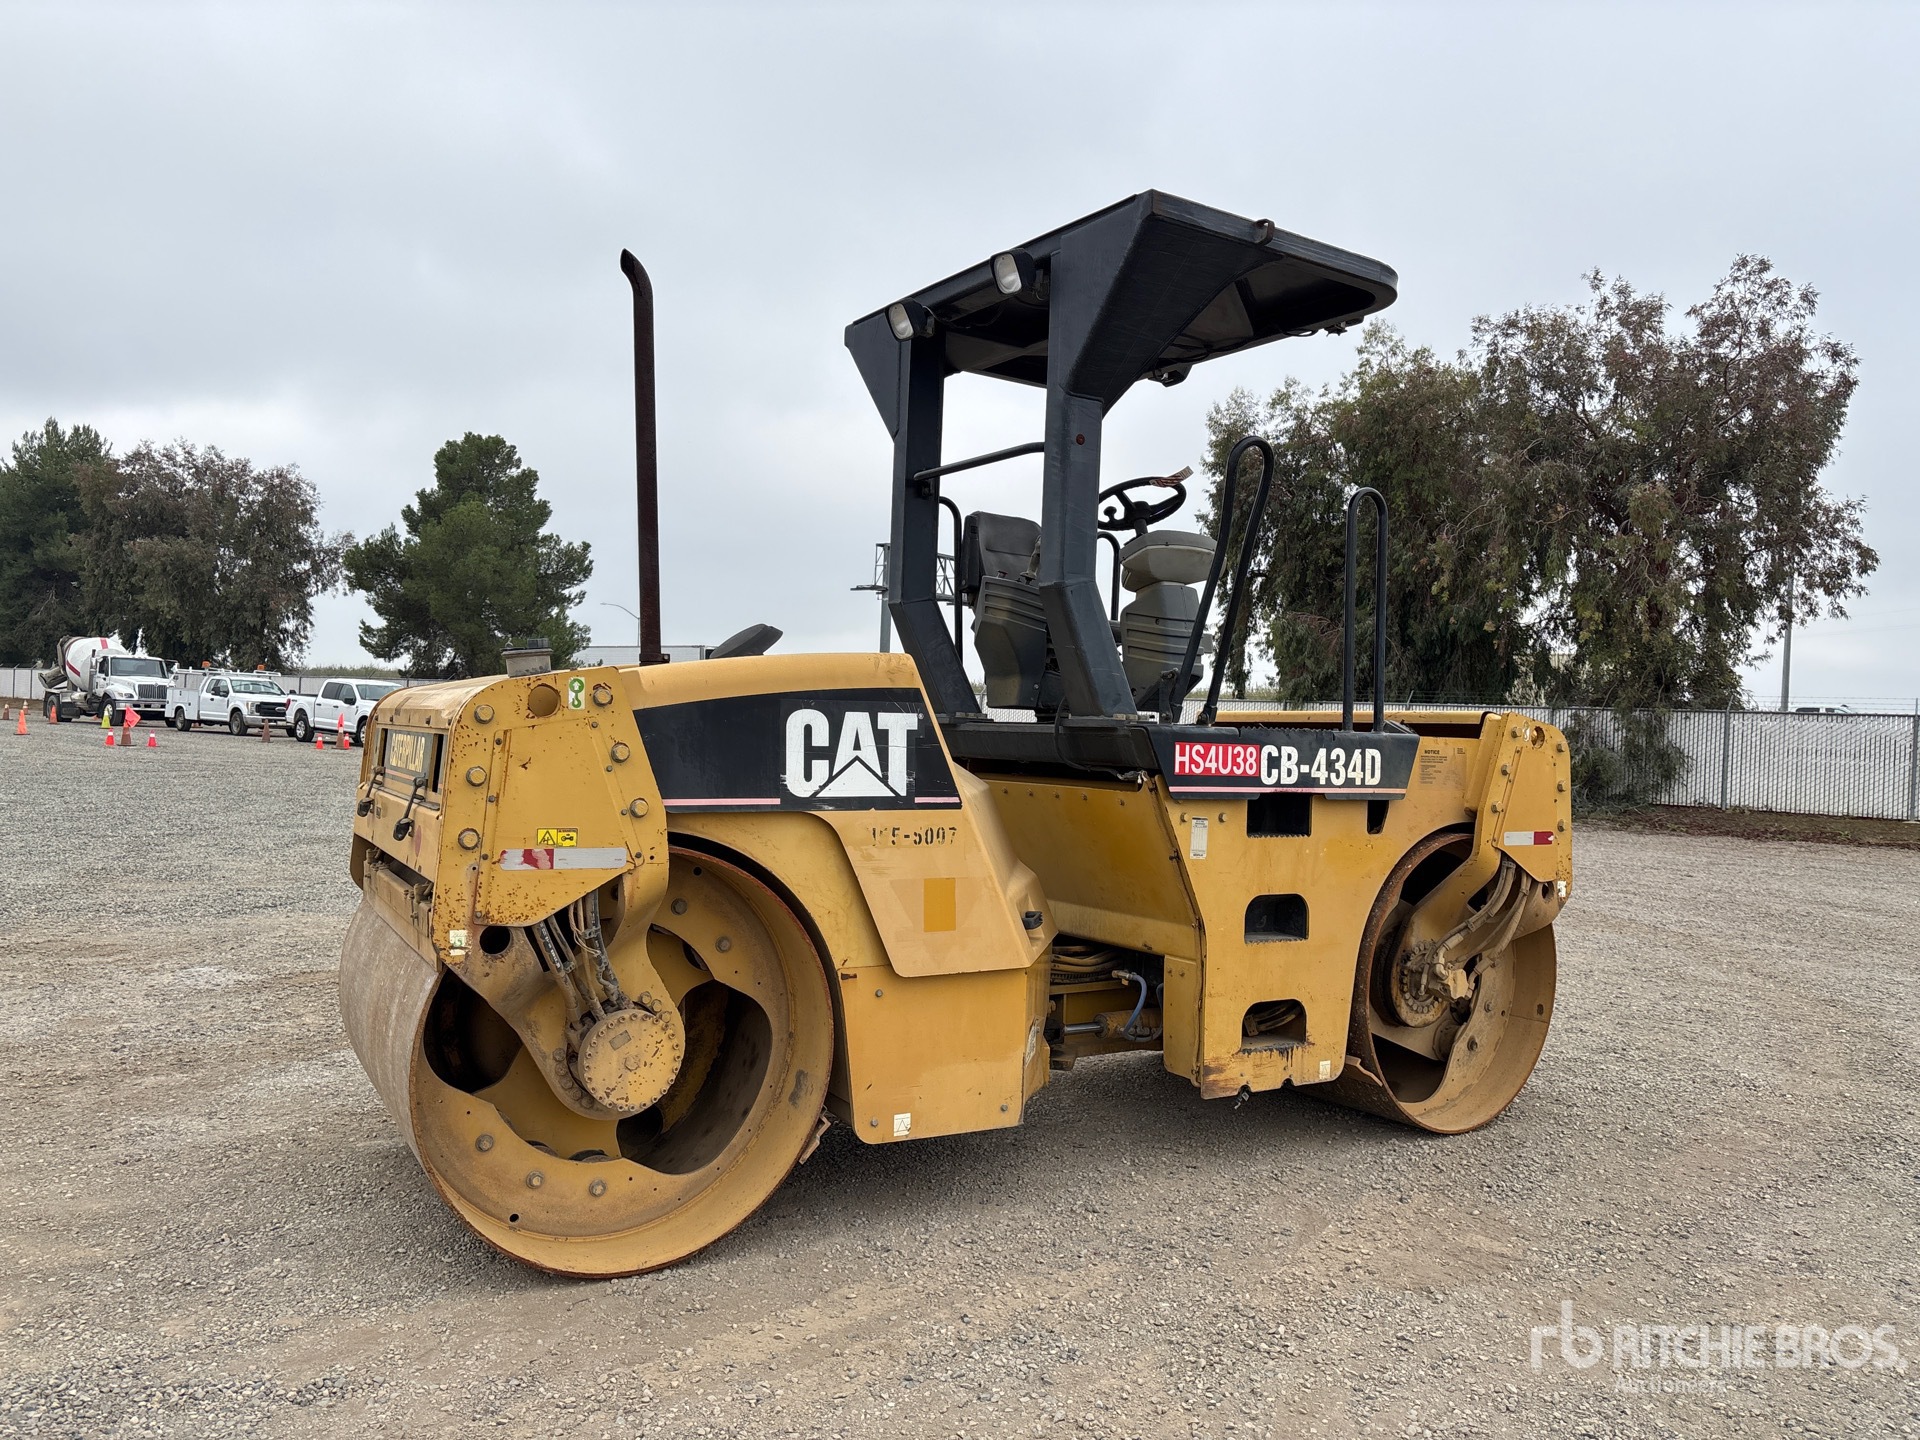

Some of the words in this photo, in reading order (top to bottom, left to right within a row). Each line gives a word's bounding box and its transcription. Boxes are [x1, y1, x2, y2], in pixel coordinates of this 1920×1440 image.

[390, 733, 426, 773] CATERPILLAR
[786, 709, 918, 797] CAT
[1174, 744, 1257, 774] HS4U38
[1260, 745, 1382, 786] CB-434D
